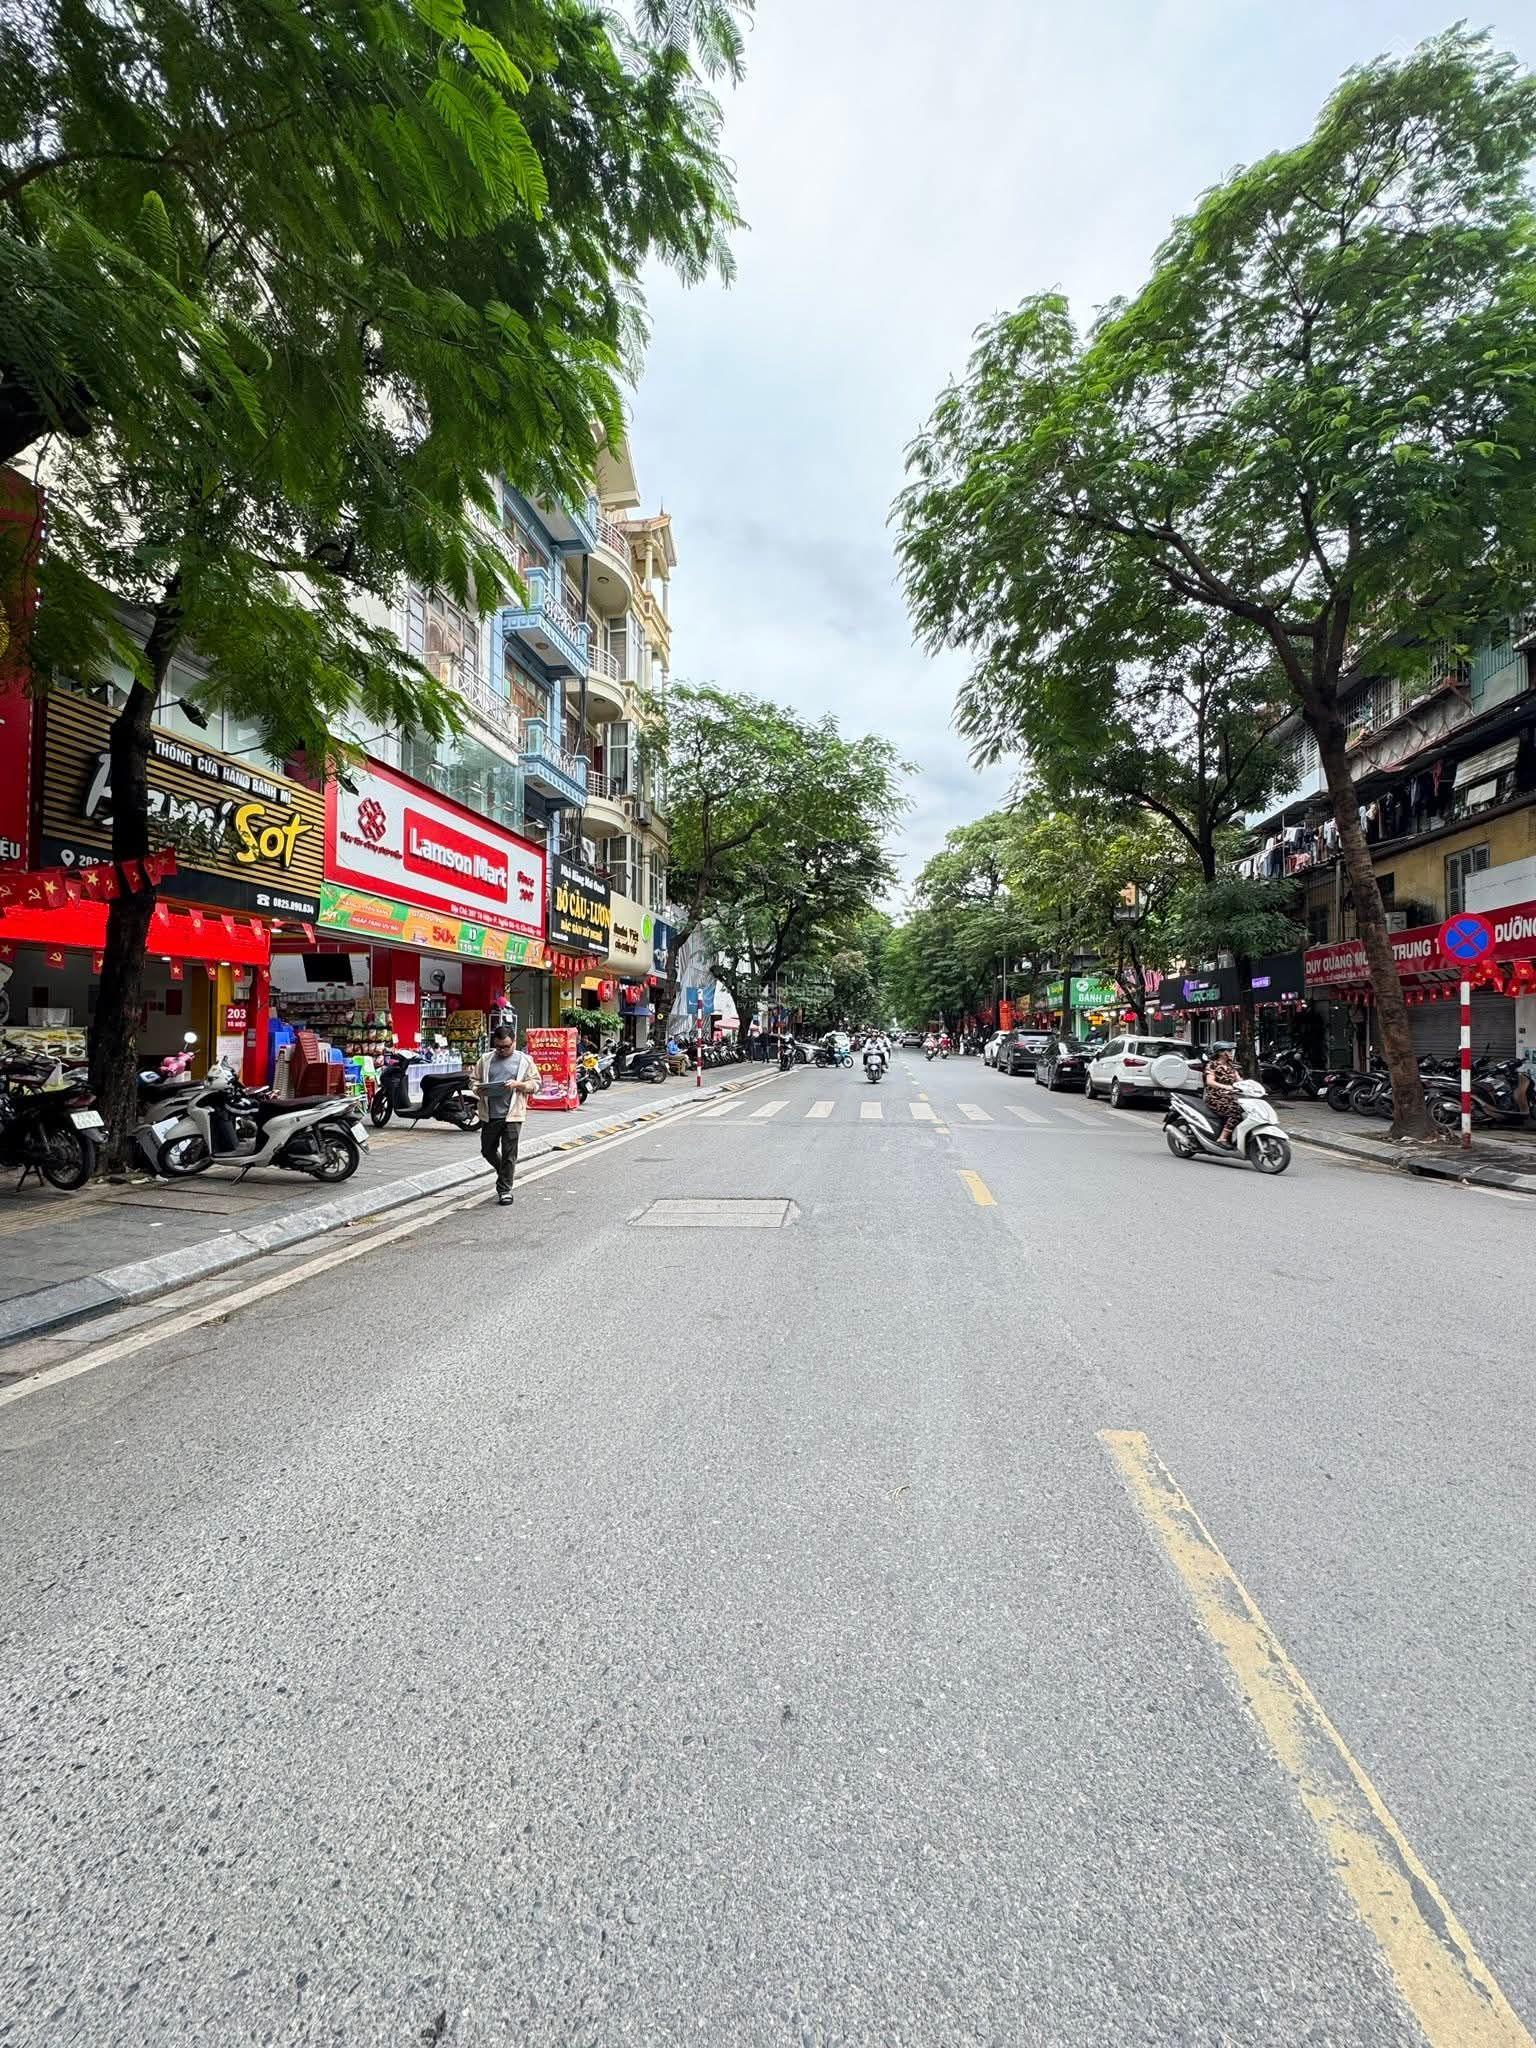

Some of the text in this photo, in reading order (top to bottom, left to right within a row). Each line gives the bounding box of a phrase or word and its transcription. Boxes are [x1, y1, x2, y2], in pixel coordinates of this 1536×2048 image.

[154, 740, 192, 767] THỐNG
[197, 756, 218, 777] CỬA
[410, 827, 473, 877] Lamson
[473, 854, 507, 888] Mart
[1392, 938, 1431, 960] TRUNG
[227, 1008, 246, 1019] 203
